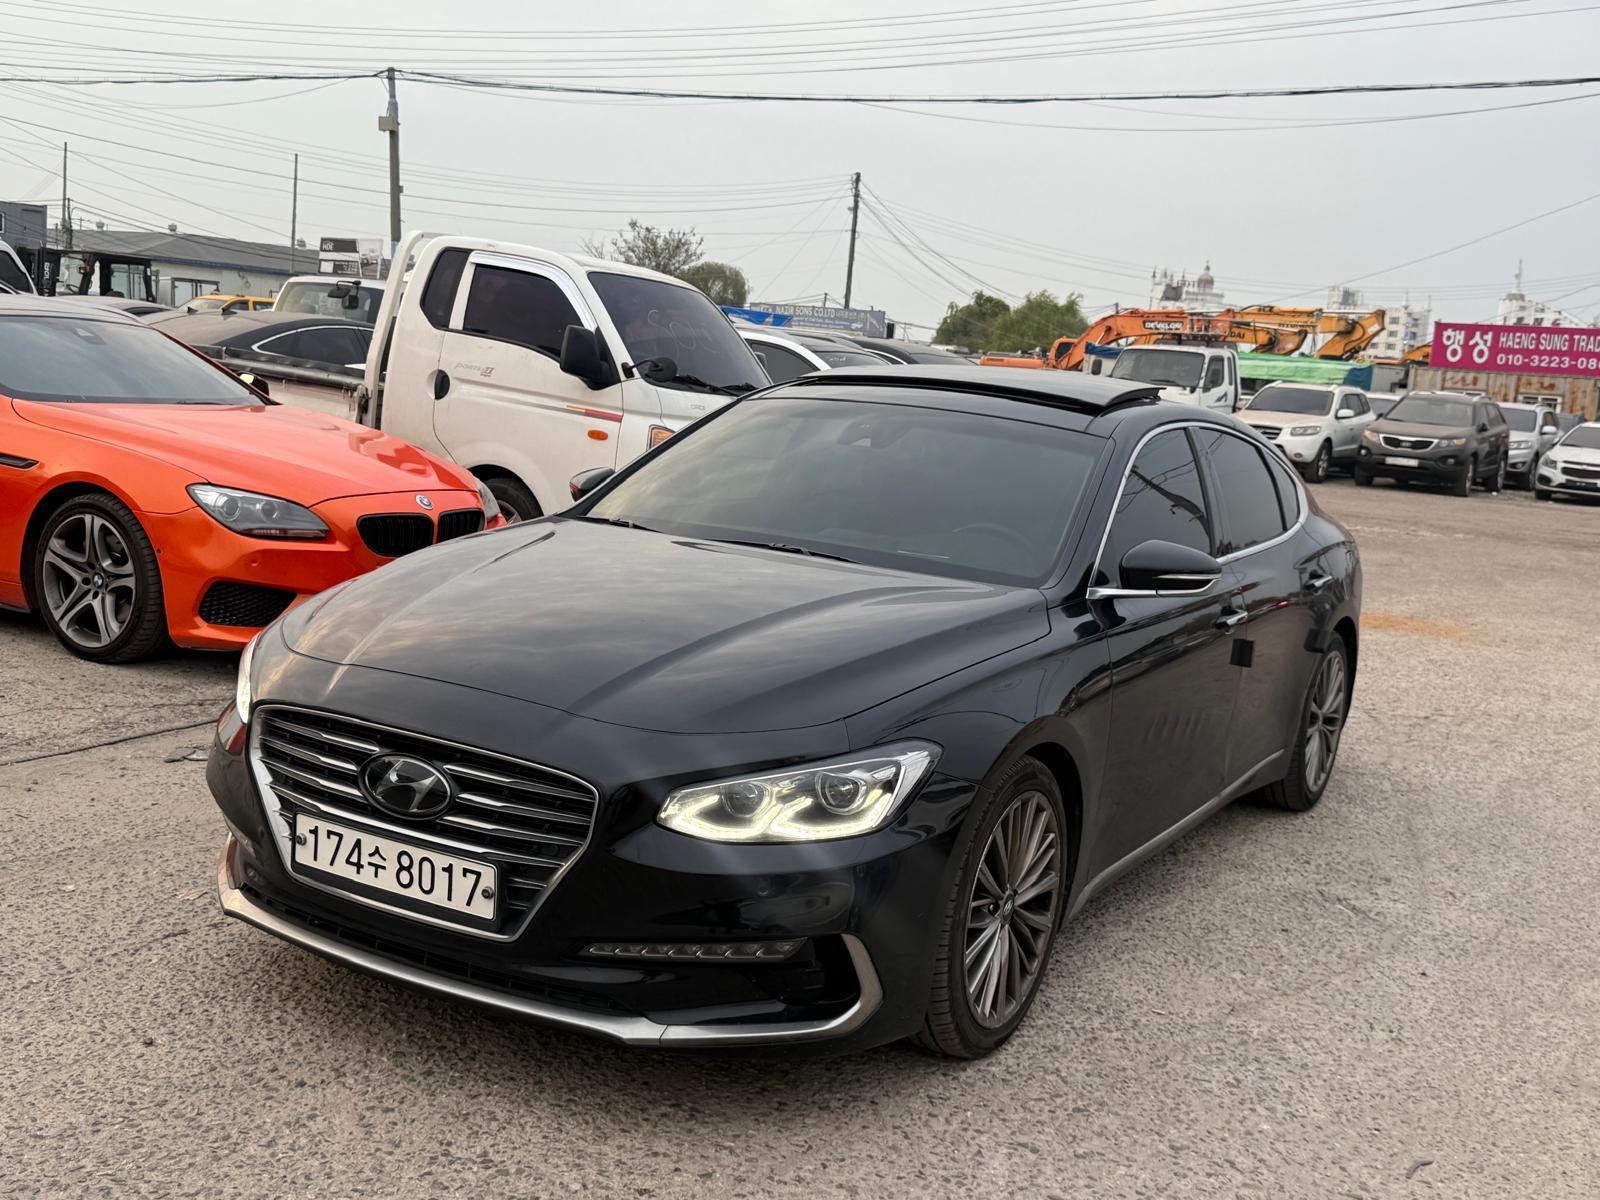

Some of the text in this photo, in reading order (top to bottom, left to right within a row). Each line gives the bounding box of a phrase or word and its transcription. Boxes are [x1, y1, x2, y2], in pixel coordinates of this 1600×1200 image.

[1442, 328, 1493, 364] 행성
[1499, 332, 1537, 350] HAENG
[1539, 334, 1569, 351] SUNG
[1496, 353, 1600, 369] 010-3223-08
[308, 825, 482, 907] 174수8017
